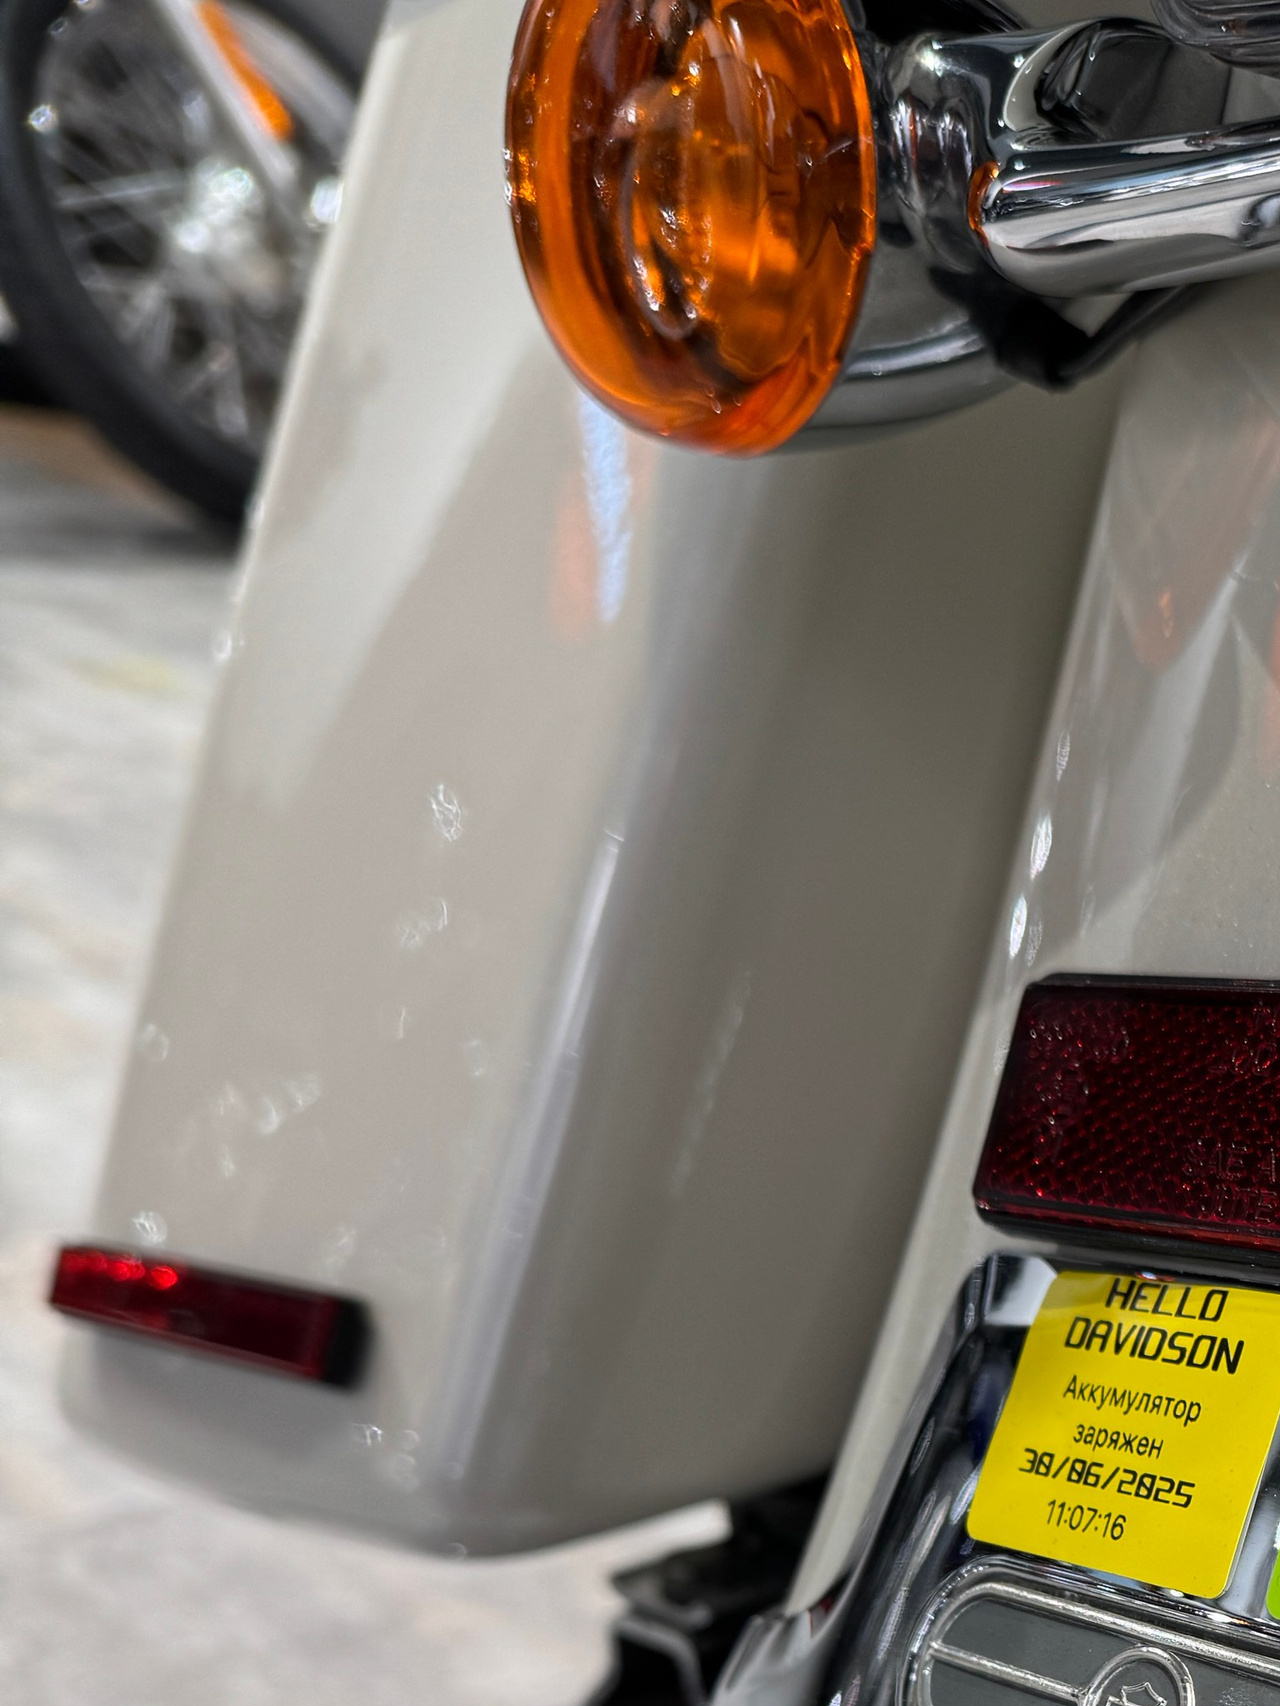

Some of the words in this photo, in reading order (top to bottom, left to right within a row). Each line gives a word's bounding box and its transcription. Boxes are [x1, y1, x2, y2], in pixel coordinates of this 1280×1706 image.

[1105, 1277, 1229, 1323] HELLO
[1064, 1316, 1245, 1375] DAVIDSON
[1063, 1374, 1202, 1427] Аккумулятор
[1073, 1423, 1164, 1459] заряжен
[1019, 1447, 1196, 1509] 30/06/2025
[1047, 1499, 1127, 1541] 11:07:16
